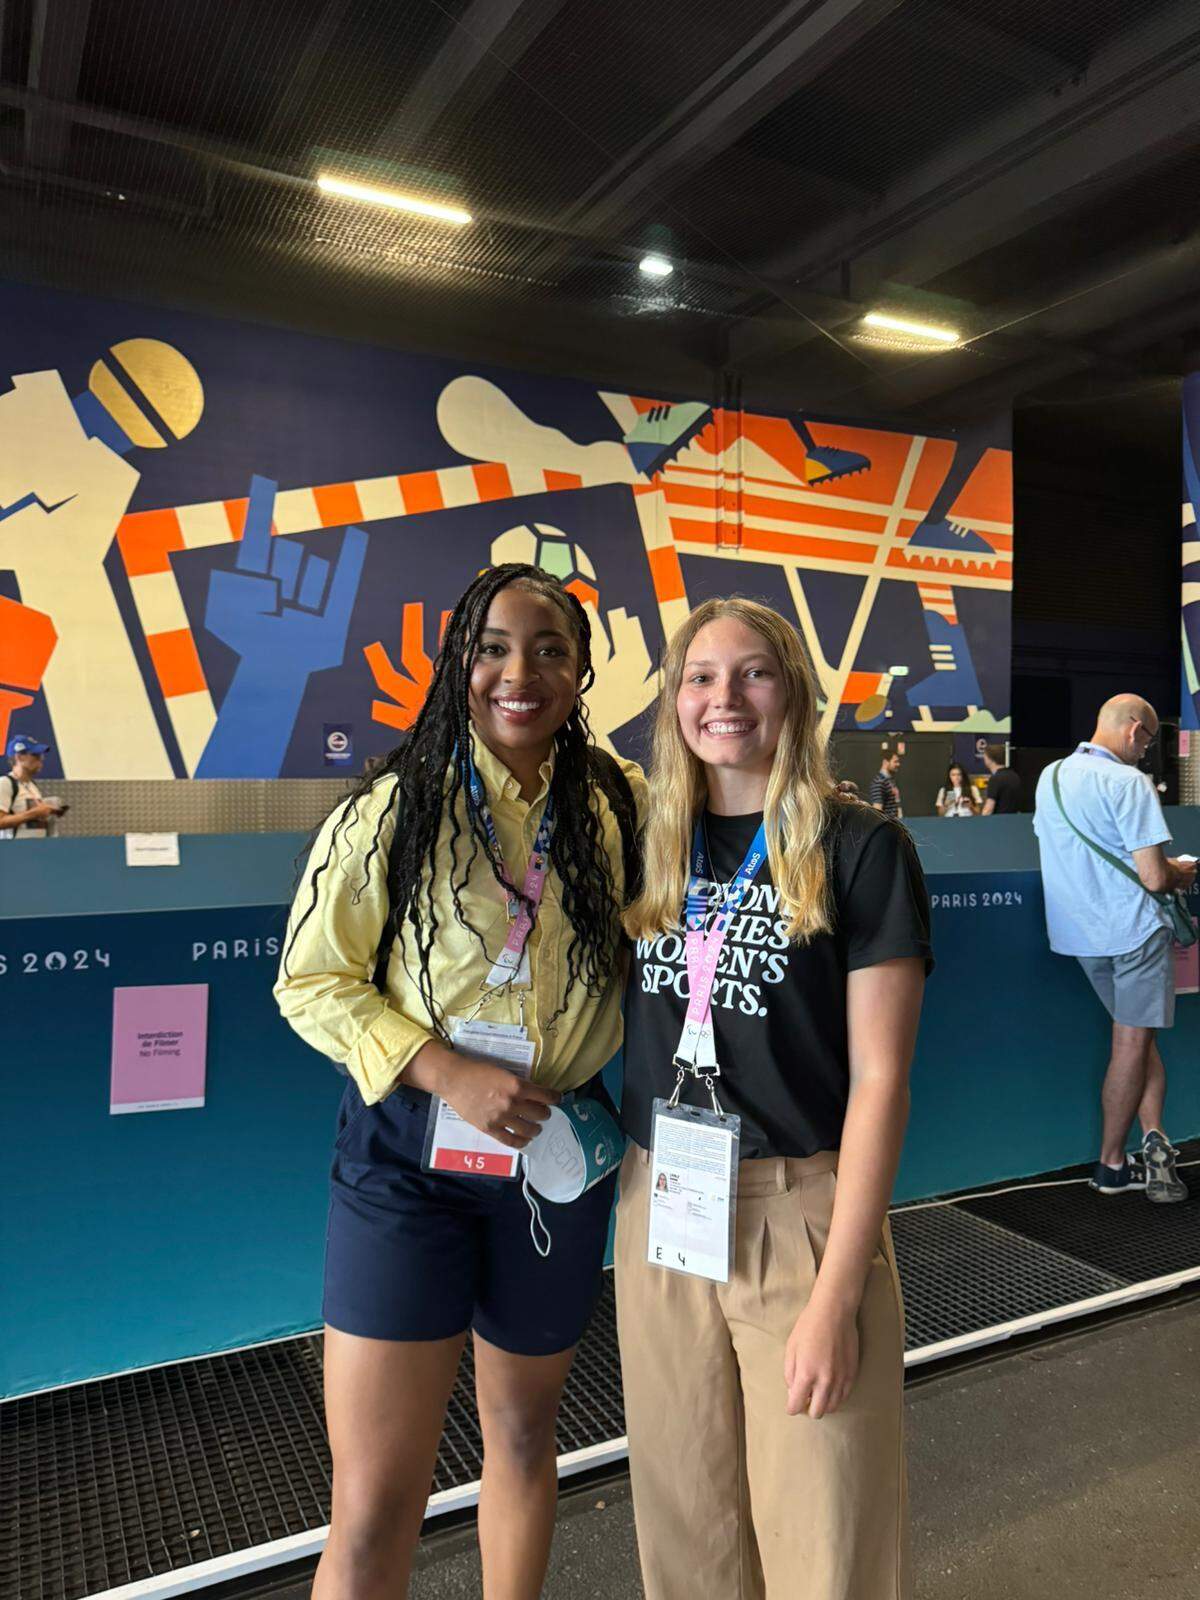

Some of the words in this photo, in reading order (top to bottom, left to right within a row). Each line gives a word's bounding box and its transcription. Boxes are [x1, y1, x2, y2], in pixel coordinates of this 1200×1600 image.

[744, 852, 761, 876] Atos
[931, 892, 977, 909] PARIS
[982, 891, 1022, 906] 2024
[192, 936, 280, 962] PARIS
[656, 1246, 662, 1260] E
[678, 1252, 686, 1266] 4
